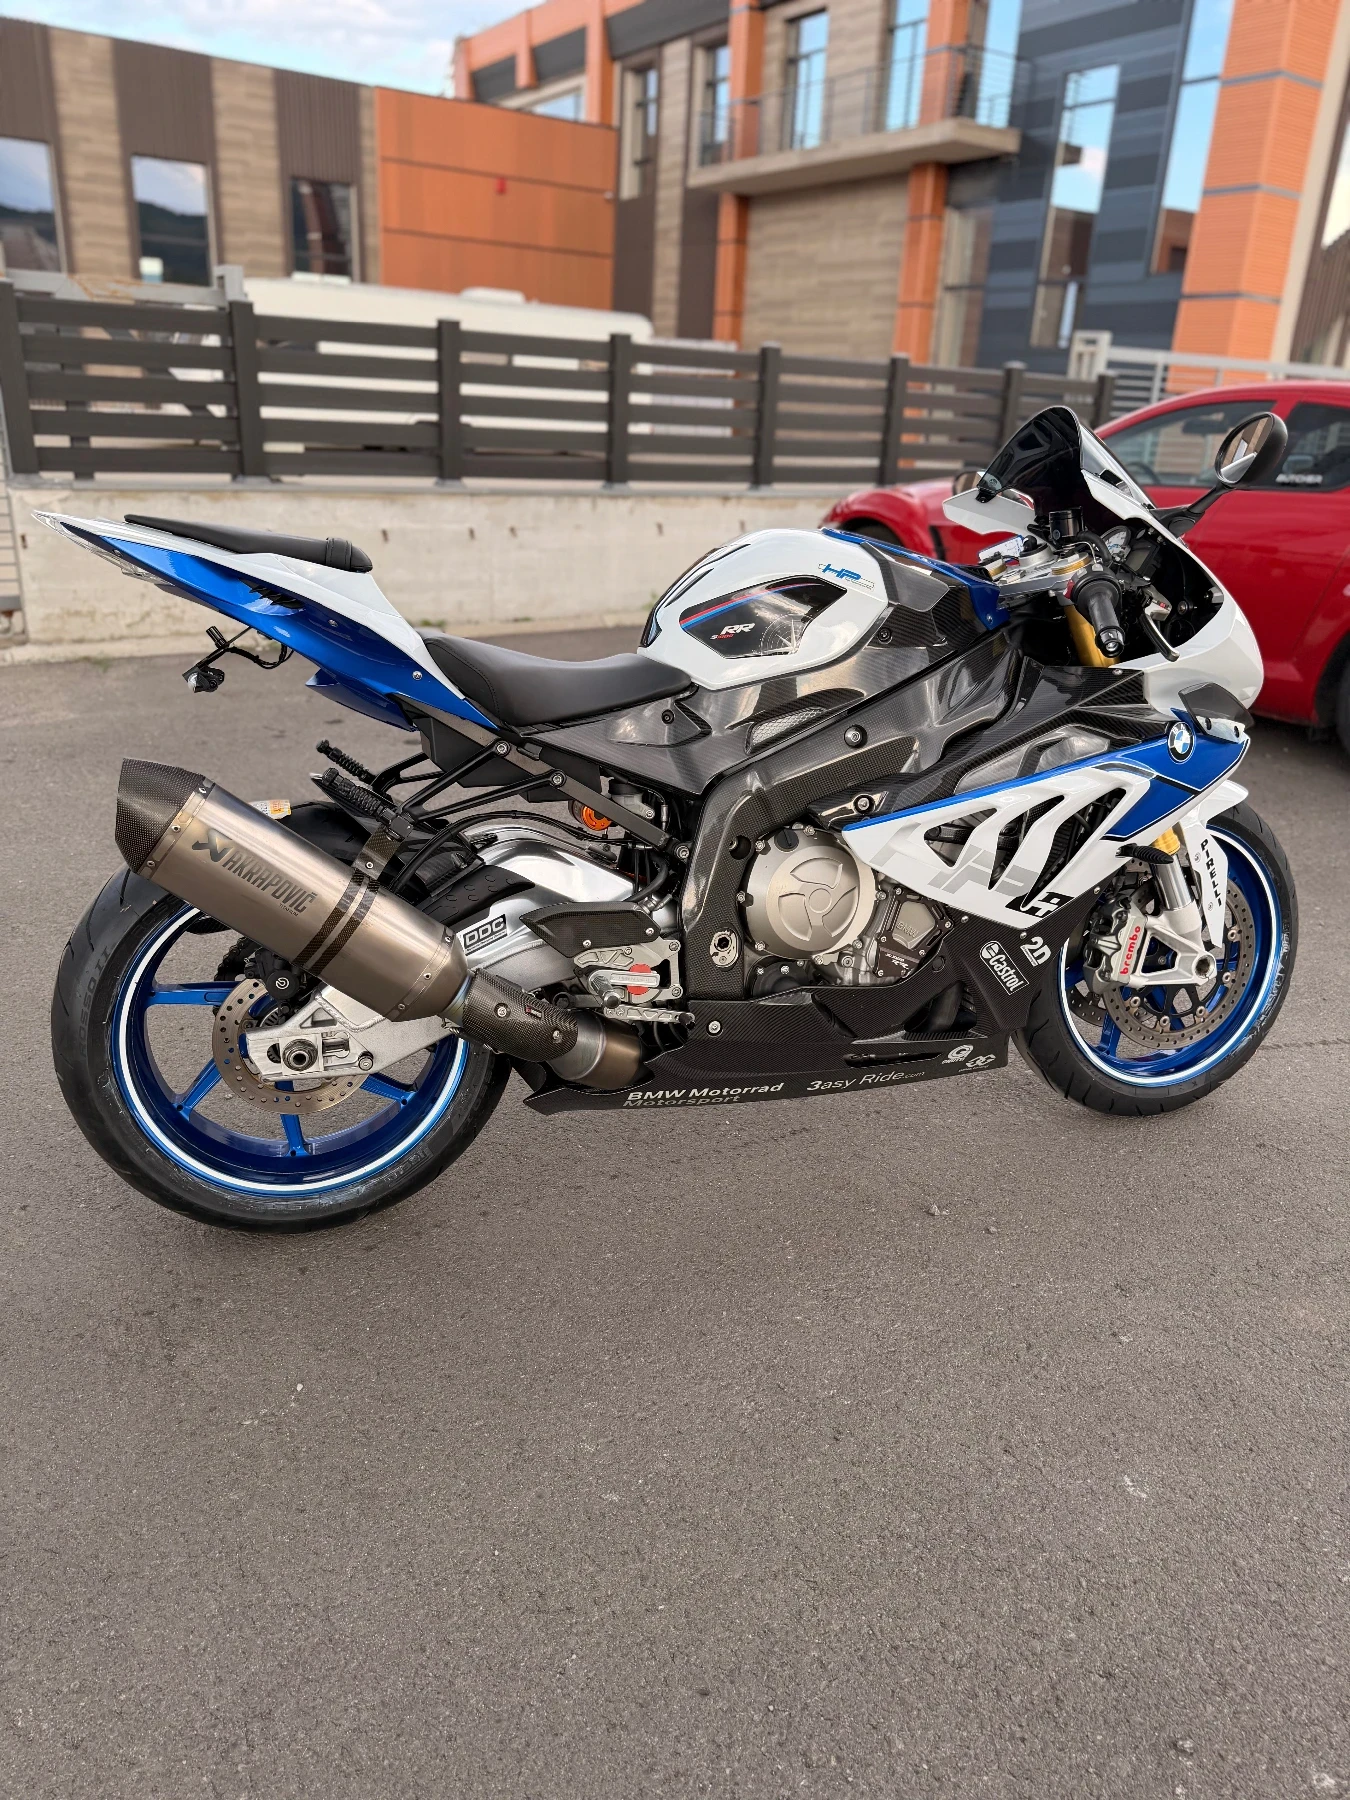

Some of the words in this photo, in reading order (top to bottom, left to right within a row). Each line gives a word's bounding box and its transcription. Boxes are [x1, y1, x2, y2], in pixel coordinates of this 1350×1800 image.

[720, 623, 756, 635] RR
[1200, 838, 1222, 907] PIRELLI
[465, 917, 506, 946] DDC
[1119, 925, 1141, 976] brembo
[988, 954, 1024, 992] Castrol
[627, 1089, 686, 1101] BMW
[688, 1082, 784, 1098] Motorrad
[806, 1078, 857, 1091] 3asy
[622, 1095, 741, 1107] Motorsport
